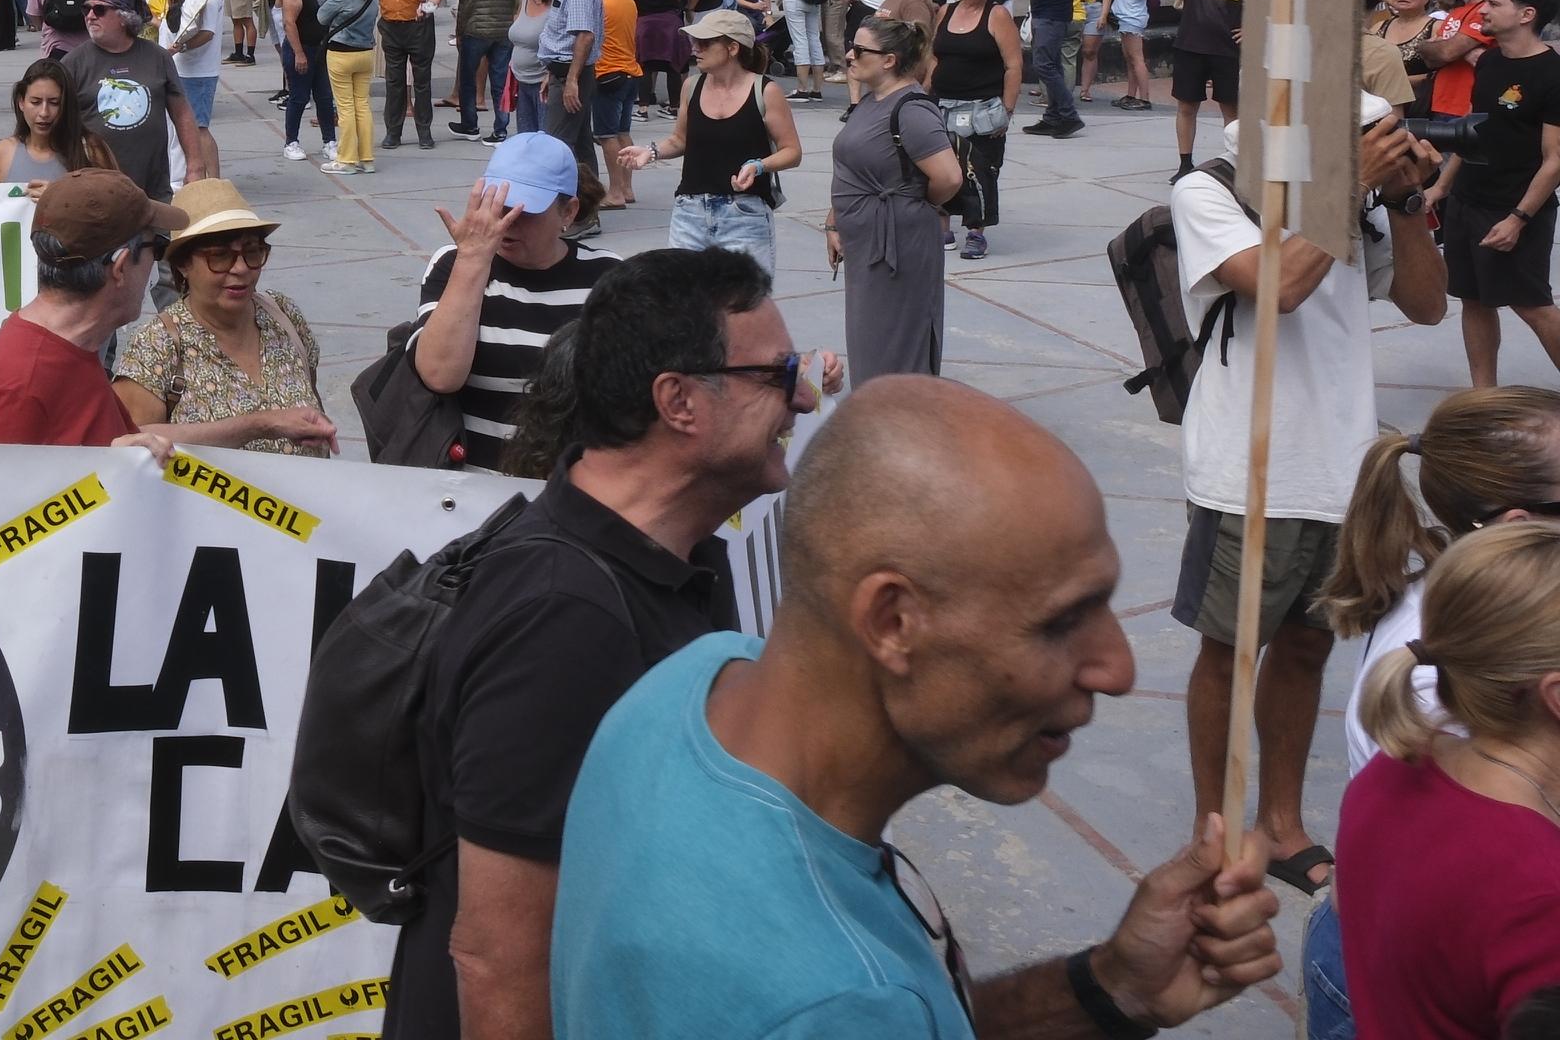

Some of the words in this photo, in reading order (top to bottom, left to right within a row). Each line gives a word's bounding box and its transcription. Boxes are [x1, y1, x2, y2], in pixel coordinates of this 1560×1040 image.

[190, 468, 306, 537] FRAGIL
[216, 910, 331, 977] FRAGIL
[33, 951, 140, 1034] FRAGIL
